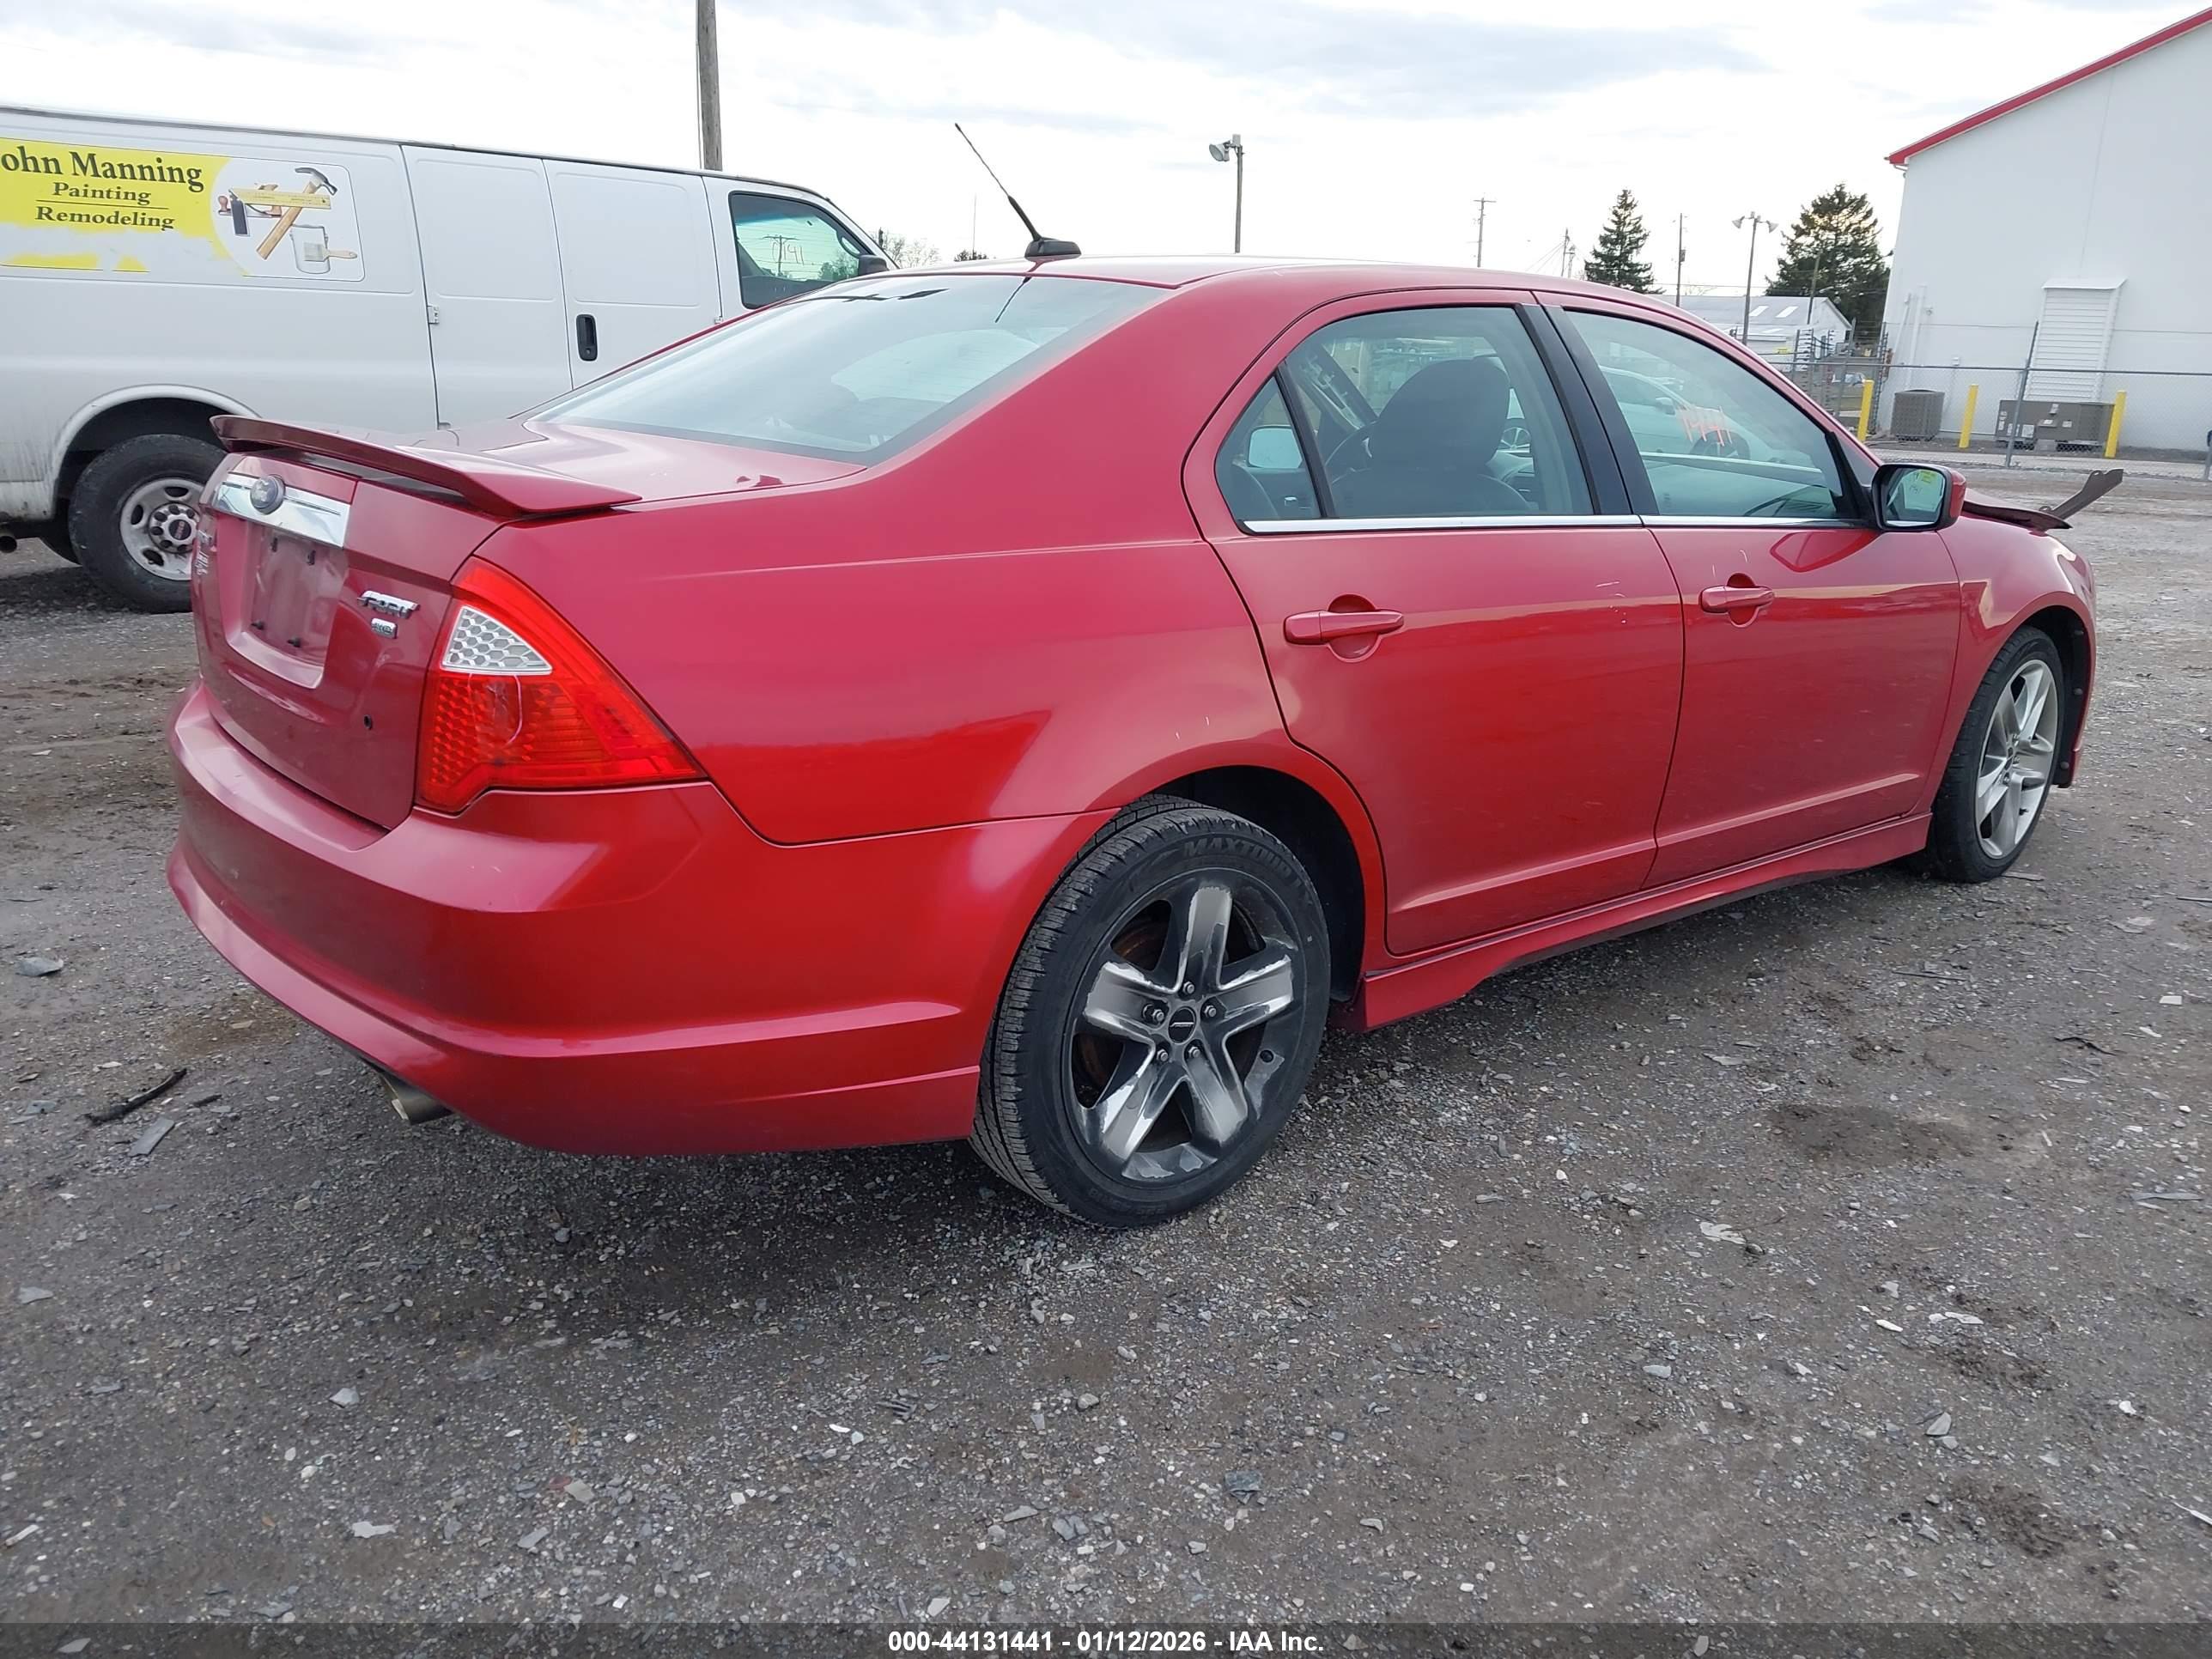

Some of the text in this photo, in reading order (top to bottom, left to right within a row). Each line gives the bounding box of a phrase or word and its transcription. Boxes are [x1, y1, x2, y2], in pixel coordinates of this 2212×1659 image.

[69, 151, 204, 193] Manning
[52, 181, 151, 205] Painting
[35, 206, 175, 231] Remodeling
